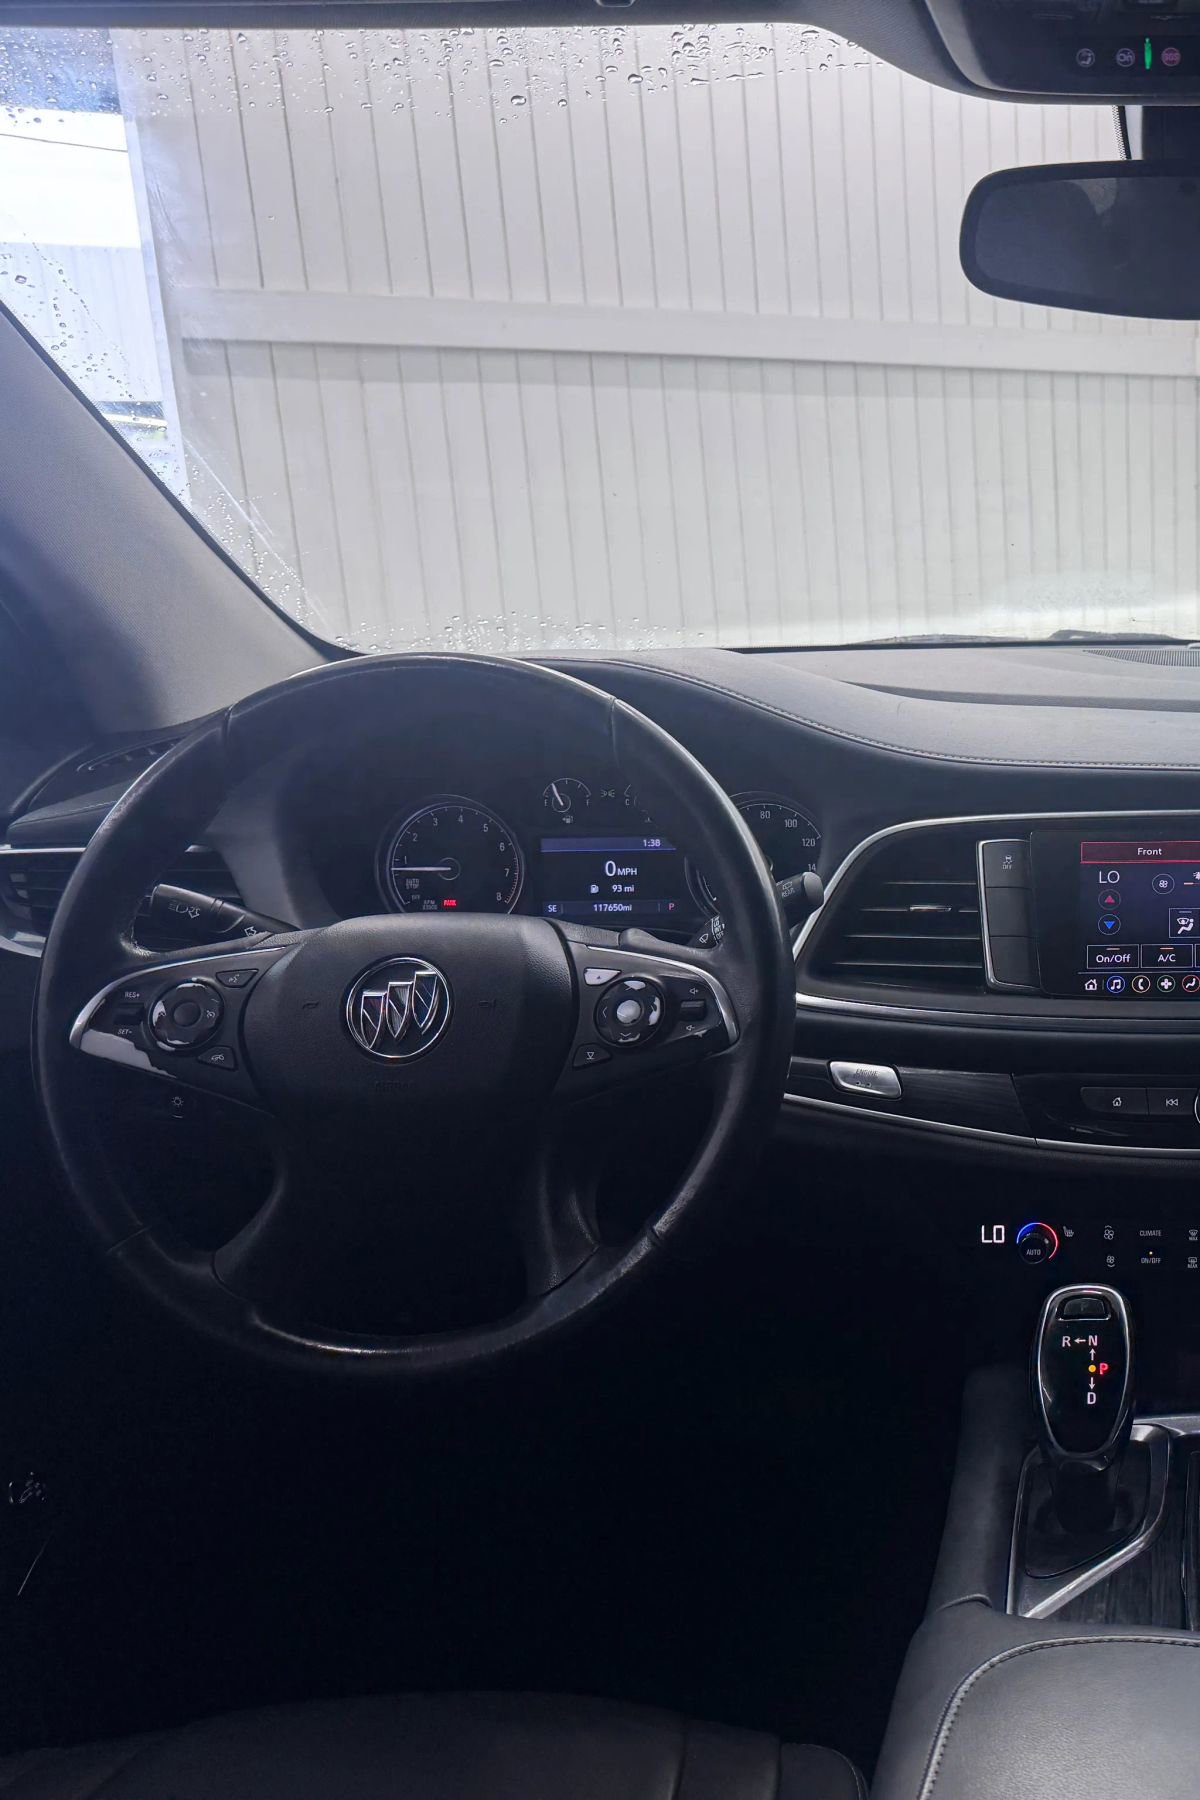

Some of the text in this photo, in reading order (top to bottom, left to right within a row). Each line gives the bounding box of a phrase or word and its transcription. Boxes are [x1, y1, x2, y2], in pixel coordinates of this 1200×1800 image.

[457, 815, 464, 823] 4
[759, 810, 771, 819] 80
[432, 817, 439, 826] 3
[784, 819, 798, 828] 100
[483, 823, 490, 832] 5
[412, 834, 419, 842] 2
[802, 838, 816, 847] 120
[499, 842, 506, 851] 6
[643, 839, 661, 848] 1:38
[1137, 847, 1162, 856] Front
[503, 868, 511, 877] 7
[604, 860, 638, 877] 0 MPH
[1098, 870, 1120, 884] LO
[611, 884, 635, 893] 93 mi
[496, 892, 503, 901] 8
[547, 903, 675, 913] SE 117650mi P
[1095, 953, 1131, 964] On/Off
[1157, 953, 1177, 963] A/C
[980, 1224, 1006, 1244] LO
[1139, 1229, 1162, 1237] CLIMATE
[1061, 1335, 1071, 1348] R
[1088, 1334, 1098, 1347] N
[1099, 1362, 1109, 1375] P
[1087, 1391, 1097, 1405] D
